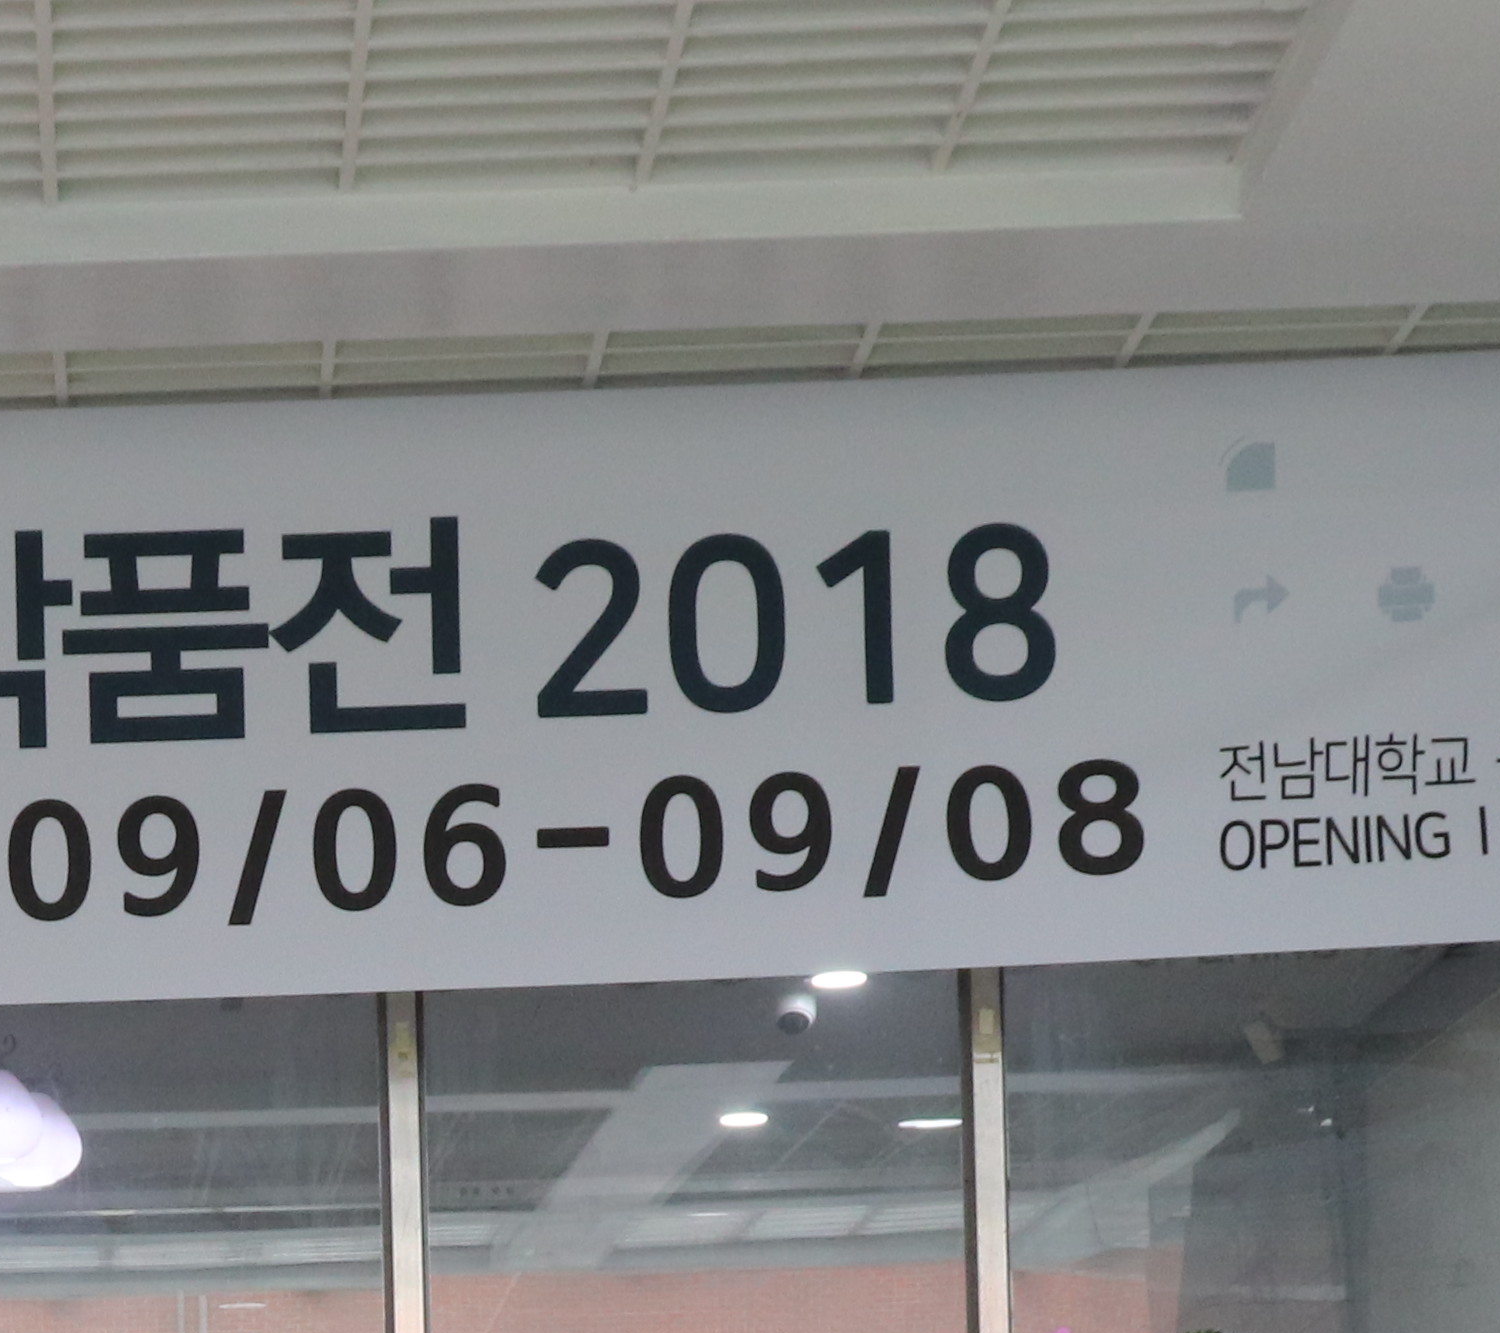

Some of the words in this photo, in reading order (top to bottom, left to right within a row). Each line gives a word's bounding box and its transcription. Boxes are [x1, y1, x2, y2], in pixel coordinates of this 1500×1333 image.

[535, 522, 1056, 719] 2018
[1218, 734, 1476, 803] 전남대학교
[7, 758, 1145, 927] 09/06-09/08
[1218, 811, 1452, 872] OPENING
